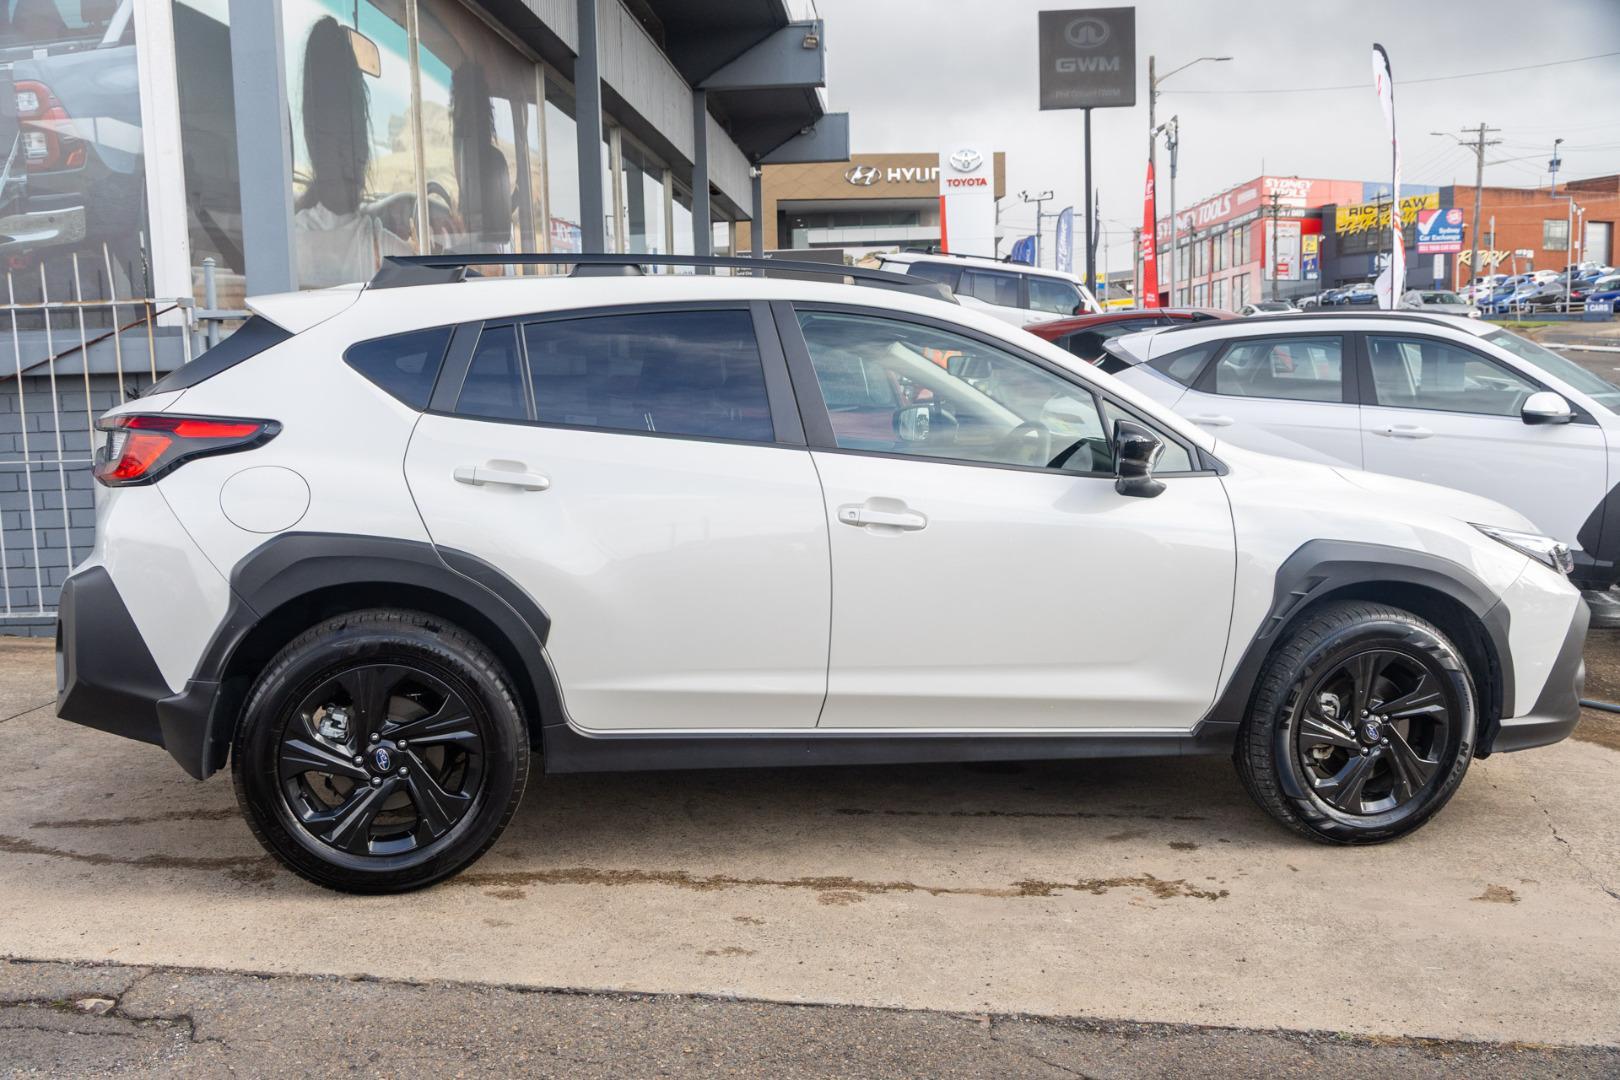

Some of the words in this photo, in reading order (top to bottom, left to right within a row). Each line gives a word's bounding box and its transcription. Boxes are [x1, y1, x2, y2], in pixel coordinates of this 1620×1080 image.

[1056, 56, 1119, 72] GWM
[947, 178, 987, 187] TOYOTA
[1265, 179, 1313, 189] SYDNEY
[1270, 187, 1308, 198] TOOLS
[1349, 206, 1373, 216] RIC
[1380, 197, 1428, 212] SAW
[1157, 212, 1196, 241] SYNEY
[1199, 194, 1232, 225] TOOLS
[1589, 303, 1609, 311] CARS
